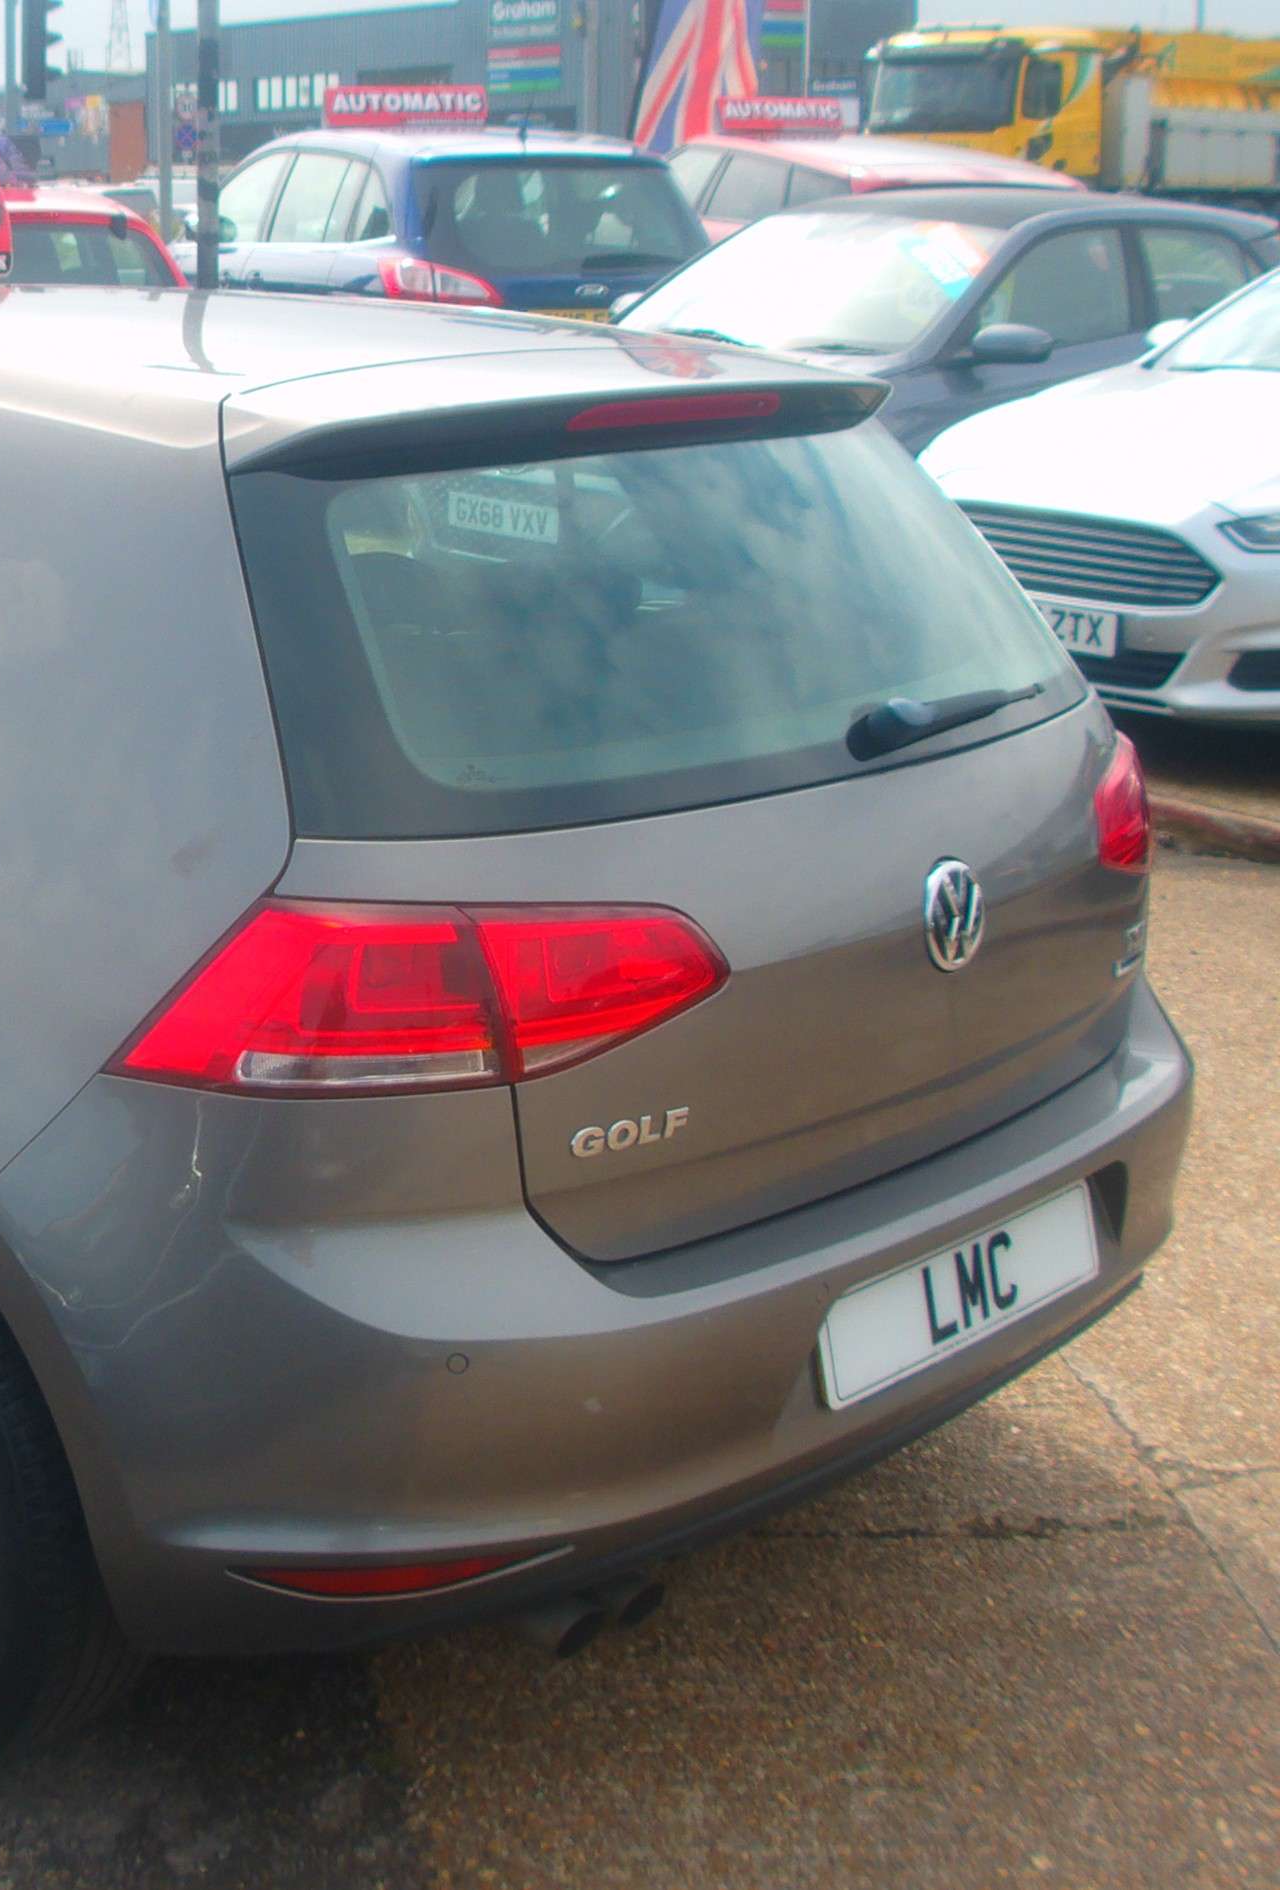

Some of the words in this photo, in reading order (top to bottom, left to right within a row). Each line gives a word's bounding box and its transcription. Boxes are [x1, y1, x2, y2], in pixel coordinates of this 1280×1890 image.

[492, 0, 557, 20] Graham
[332, 92, 484, 113] AUTOMATIC
[725, 101, 841, 119] AUTOMATIC
[455, 497, 505, 530] GX68
[509, 503, 549, 537] VXV
[1050, 607, 1105, 648] ZTX
[570, 1106, 690, 1158] GOLF
[921, 1230, 1019, 1346] LMC
